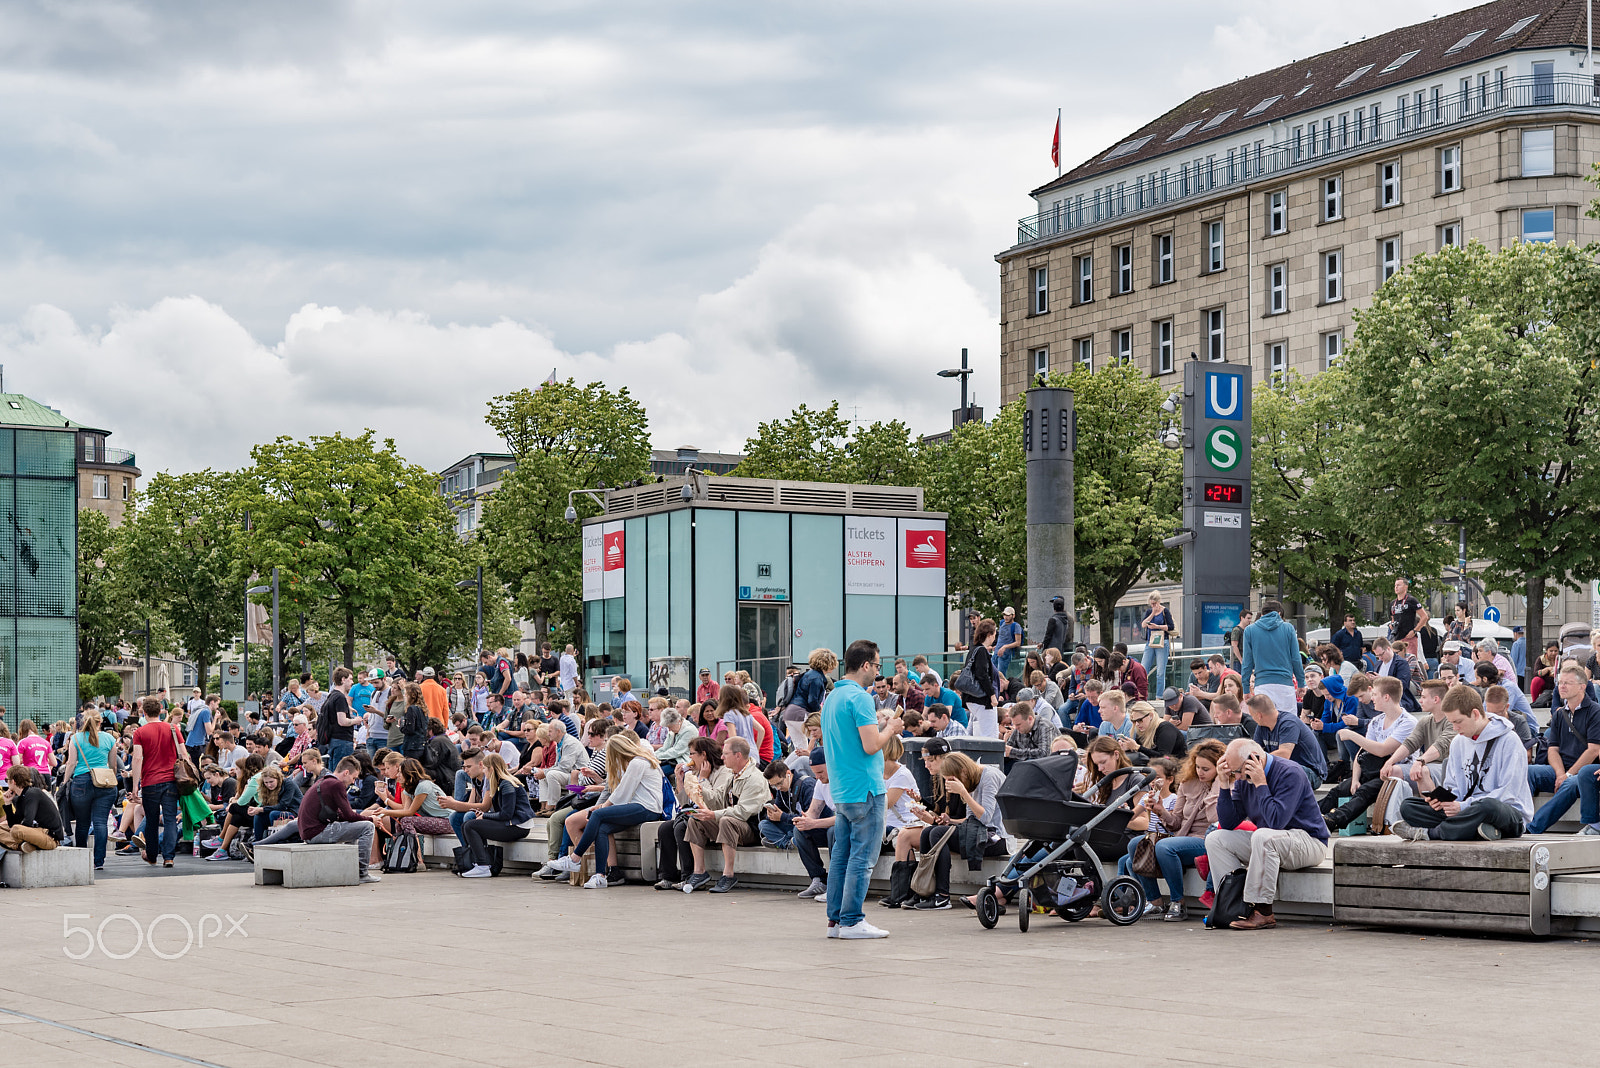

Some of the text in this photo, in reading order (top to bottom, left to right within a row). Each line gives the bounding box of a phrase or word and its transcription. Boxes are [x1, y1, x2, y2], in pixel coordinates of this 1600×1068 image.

[1210, 375, 1237, 416] U
[1211, 429, 1237, 469] S
[847, 527, 885, 541] Tickets
[584, 535, 602, 548] Tickets
[847, 550, 873, 558] ALSTER
[847, 558, 885, 567] SCHIPPERN
[741, 587, 750, 598] U
[34, 750, 45, 766] 7
